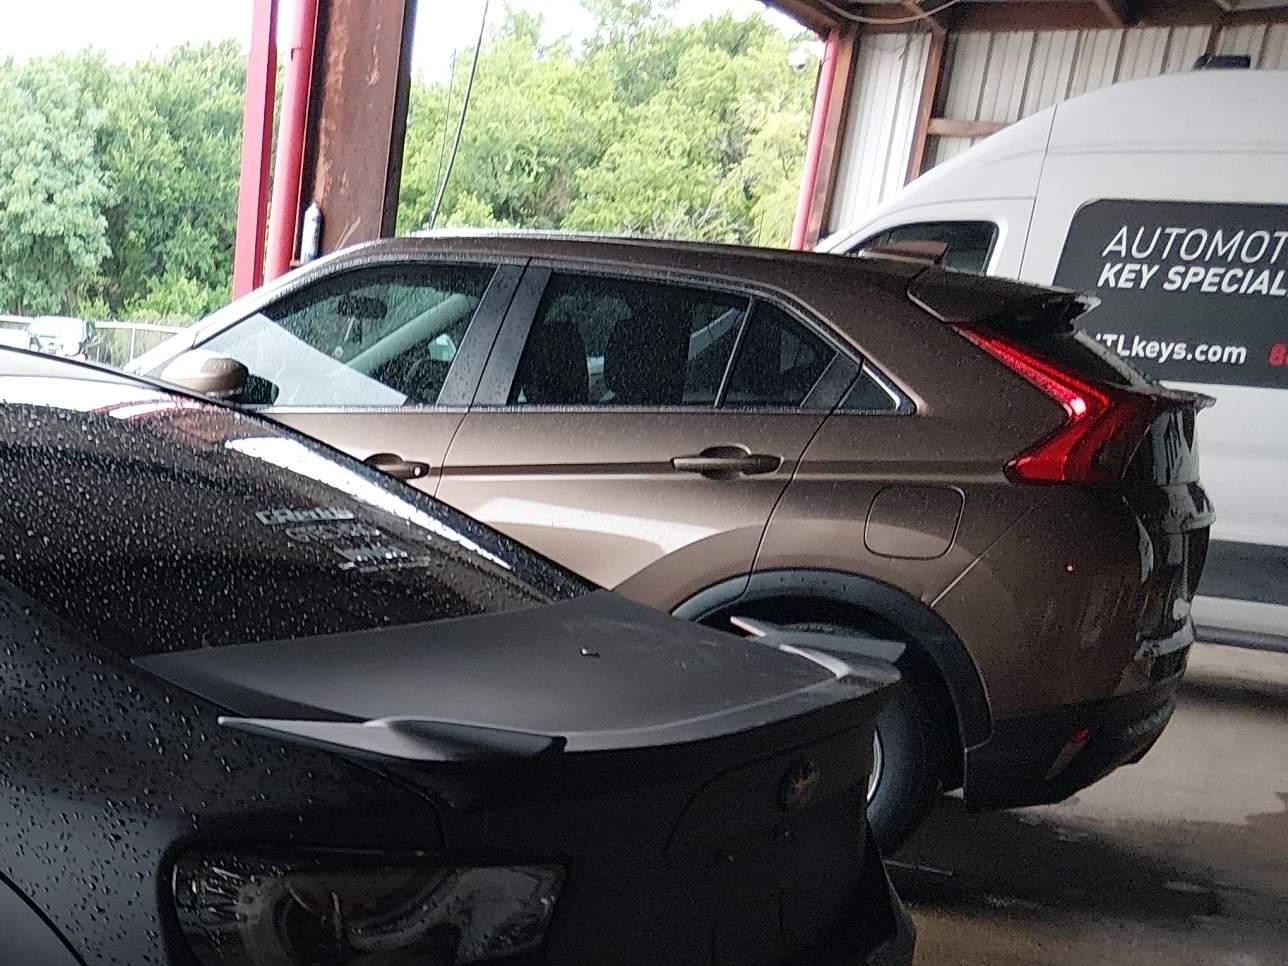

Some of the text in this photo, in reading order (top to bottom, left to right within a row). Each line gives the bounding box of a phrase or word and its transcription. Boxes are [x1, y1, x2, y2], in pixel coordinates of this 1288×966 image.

[1096, 263, 1288, 297] KEY SPECIAL
[1095, 332, 1247, 365] TLkeys.com
